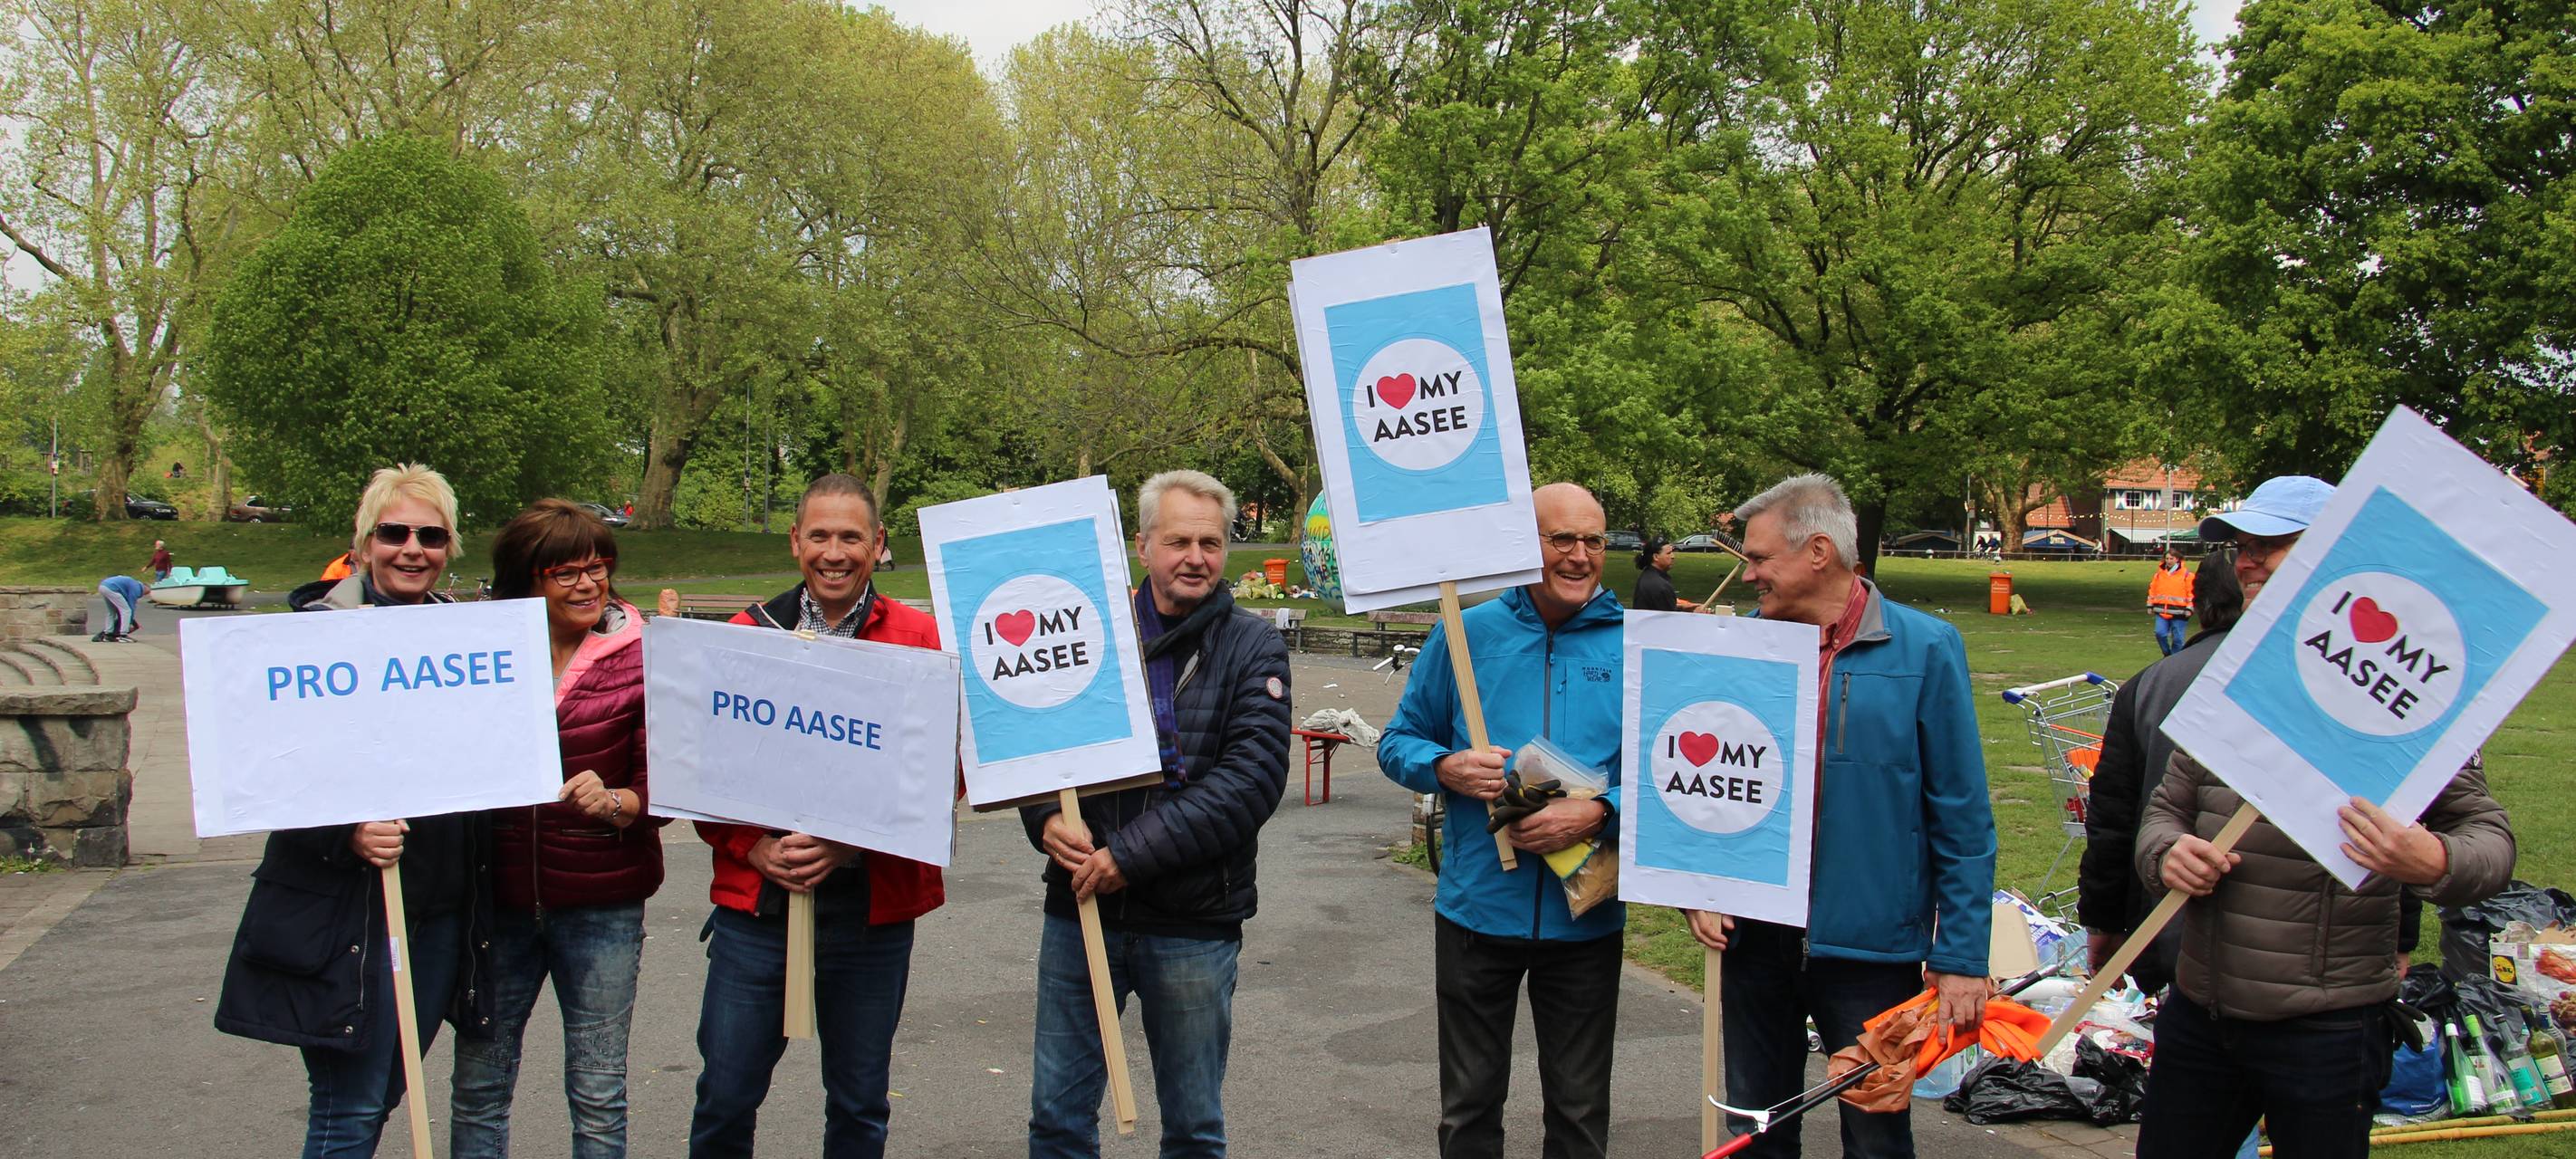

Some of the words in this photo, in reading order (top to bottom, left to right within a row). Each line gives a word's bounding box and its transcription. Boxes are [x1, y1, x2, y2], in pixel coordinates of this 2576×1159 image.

[1366, 385, 1376, 408] I
[1420, 370, 1462, 400] MY
[1373, 405, 1468, 443] AASEE
[985, 622, 994, 646] I
[1039, 606, 1081, 637] MY
[2331, 590, 2352, 615] I
[2385, 635, 2450, 684] MY
[264, 660, 359, 703] PRO
[379, 649, 515, 695] AASEE
[993, 641, 1089, 681] AASEE
[2304, 629, 2419, 720] AASEE
[710, 689, 777, 728] PRO
[783, 704, 882, 752] AASEE
[1668, 735, 1675, 759] I
[1720, 741, 1767, 769] MY
[1665, 771, 1763, 804] AASEE
